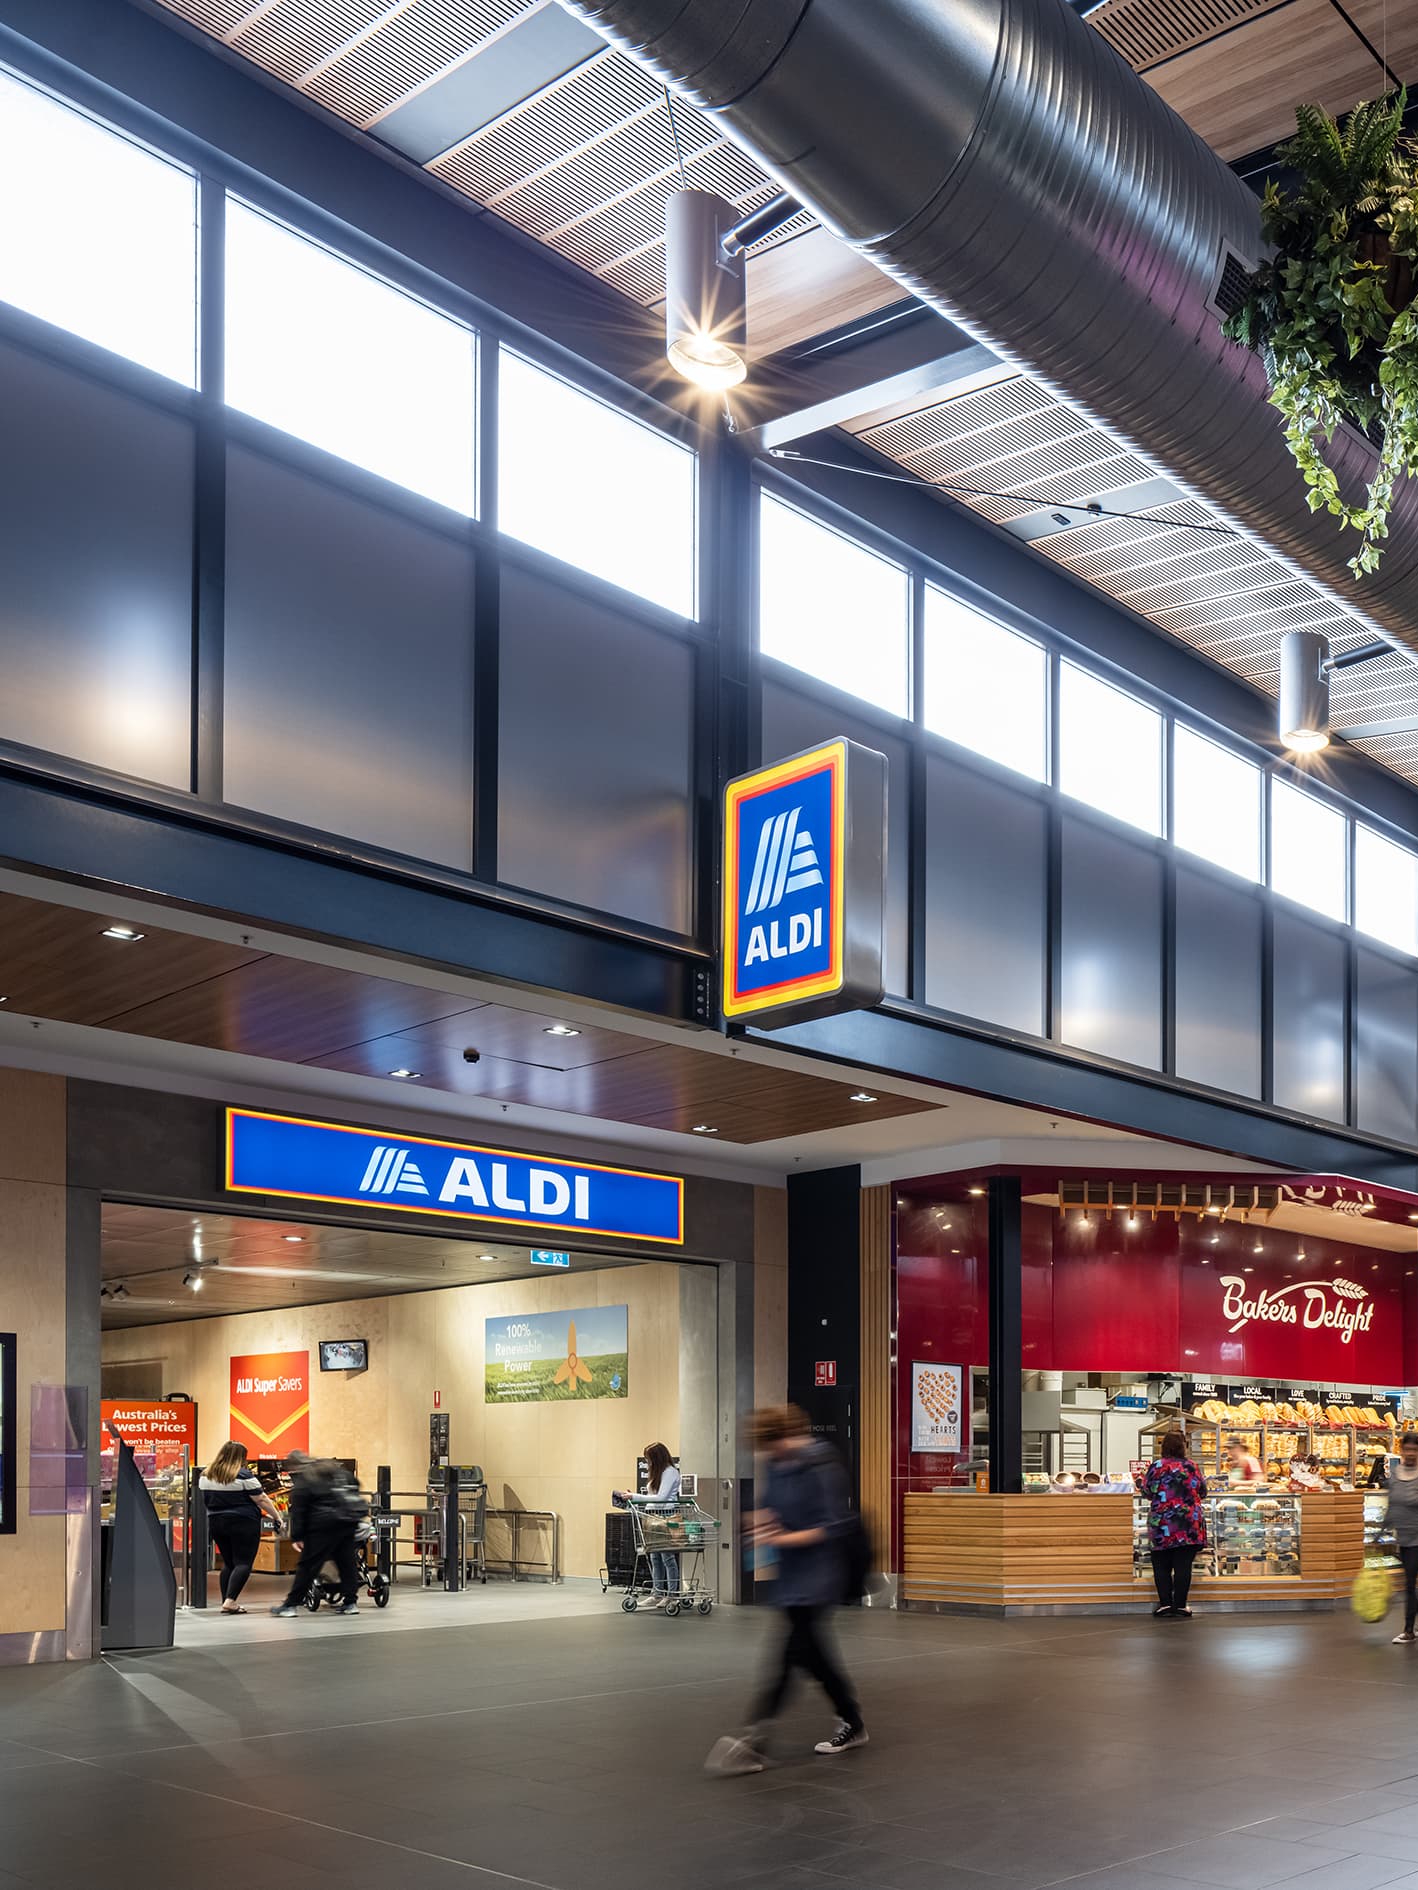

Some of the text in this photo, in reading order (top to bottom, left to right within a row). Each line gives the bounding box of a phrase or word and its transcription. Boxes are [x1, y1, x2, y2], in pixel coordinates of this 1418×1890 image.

[744, 907, 822, 967] ALDI
[438, 1156, 590, 1220] ALDI
[1219, 1275, 1375, 1344] Bakers Delight
[506, 1323, 531, 1338] 100%
[495, 1340, 542, 1357] Renewable
[504, 1360, 533, 1373] Power
[237, 1375, 302, 1397] ALDI Super Savers
[1194, 1383, 1216, 1392] FAMILY
[1243, 1386, 1262, 1395] LOCAL
[1290, 1389, 1305, 1397] LOVE
[1328, 1392, 1352, 1400] CRAFTED
[113, 1409, 177, 1420] Australia's
[151, 1422, 187, 1432] Prices
[930, 1425, 957, 1434] HEARTS
[155, 1438, 180, 1446] beaten
